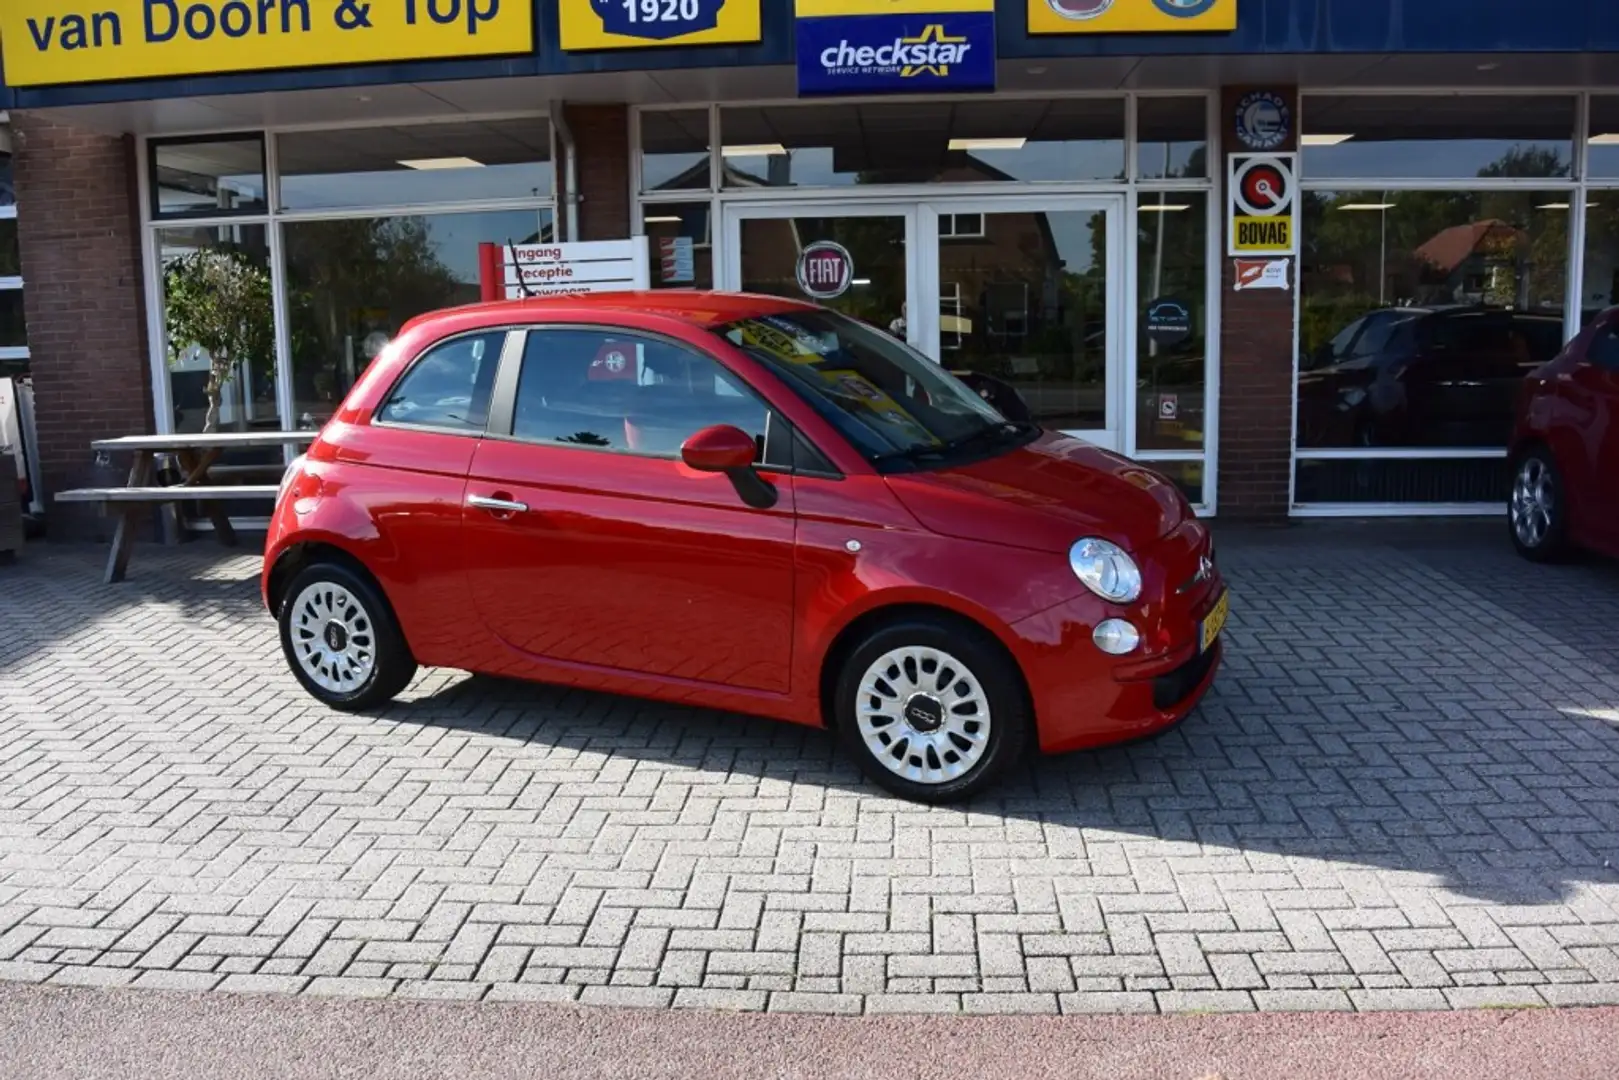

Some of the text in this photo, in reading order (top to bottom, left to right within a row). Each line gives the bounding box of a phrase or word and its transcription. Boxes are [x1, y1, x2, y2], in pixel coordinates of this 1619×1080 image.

[622, 0, 700, 22] 1920
[26, 10, 122, 51] van
[143, 0, 311, 43] Doorn
[334, 0, 373, 30] &
[820, 37, 971, 68] checkstar
[827, 66, 860, 75] SERVICE
[1238, 221, 1288, 245] BOVAG
[808, 258, 841, 283] FIAT
[517, 287, 591, 298] Sowroo
